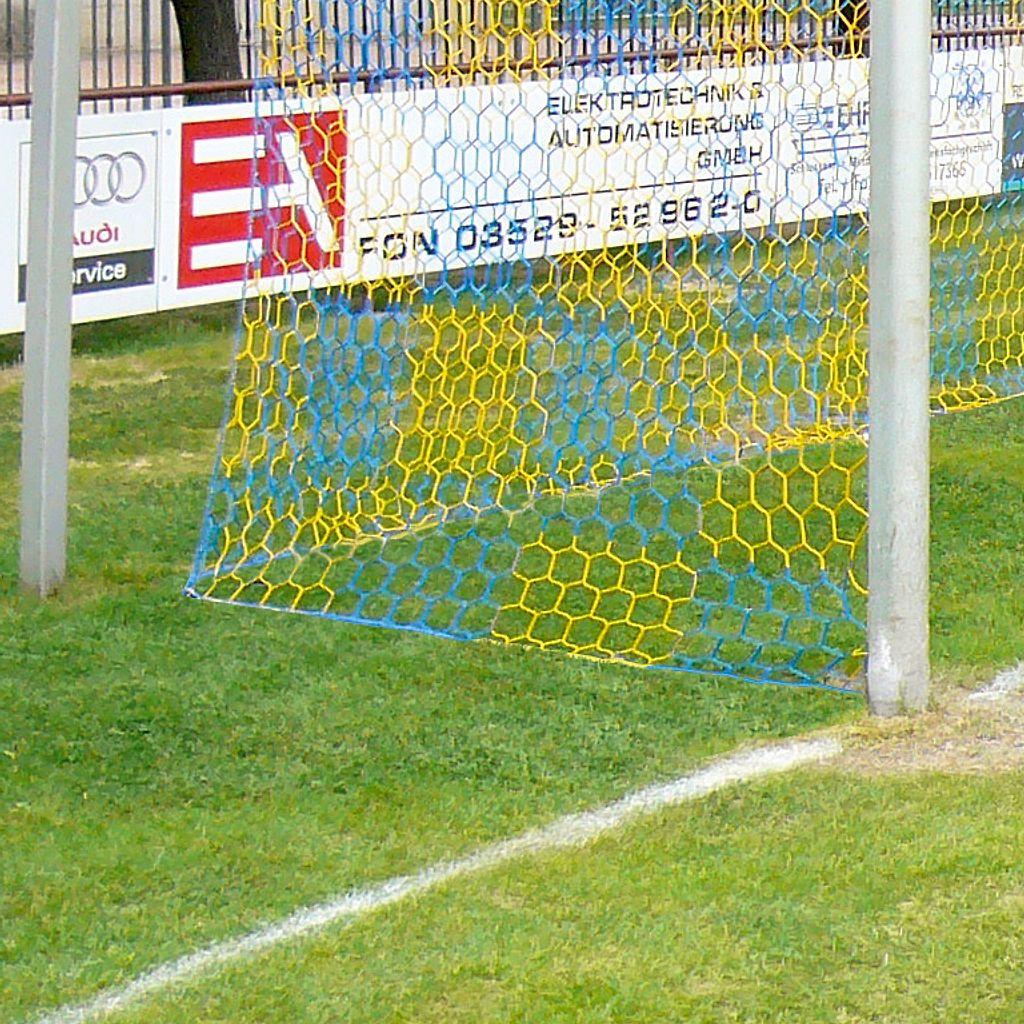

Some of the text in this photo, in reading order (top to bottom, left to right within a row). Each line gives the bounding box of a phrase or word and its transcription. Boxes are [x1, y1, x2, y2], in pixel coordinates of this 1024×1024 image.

[547, 83, 745, 116] ELEKTROTECHNIK
[548, 112, 764, 148] AUTOMATISIERUNG
[696, 145, 763, 170] GMBH
[360, 229, 438, 261] FON
[457, 212, 578, 252] 03529
